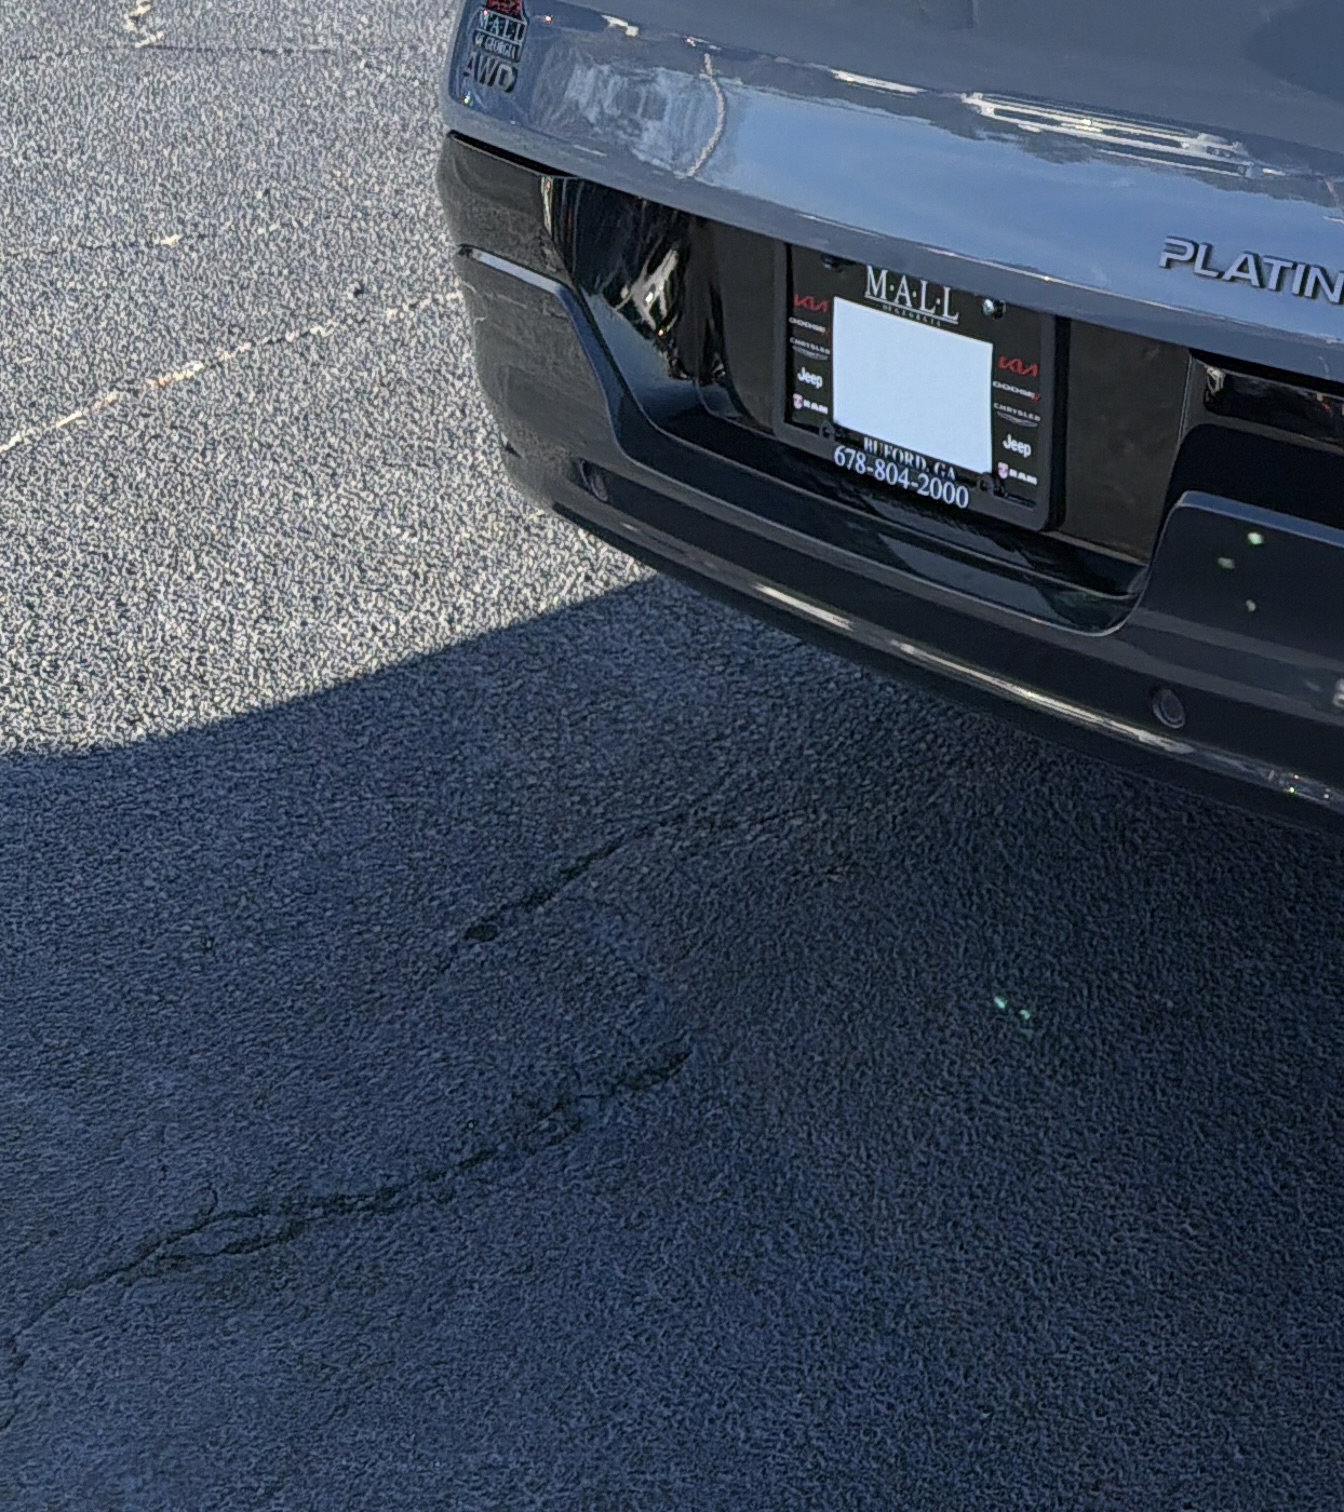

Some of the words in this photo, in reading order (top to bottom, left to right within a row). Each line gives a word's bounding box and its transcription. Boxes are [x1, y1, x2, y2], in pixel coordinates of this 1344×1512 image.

[463, 51, 518, 93] AWD
[797, 366, 823, 389] Jeep
[803, 399, 829, 416] RAM
[1002, 433, 1032, 458] Jeep
[833, 445, 969, 508] 678-804-2000
[933, 461, 957, 481] GA
